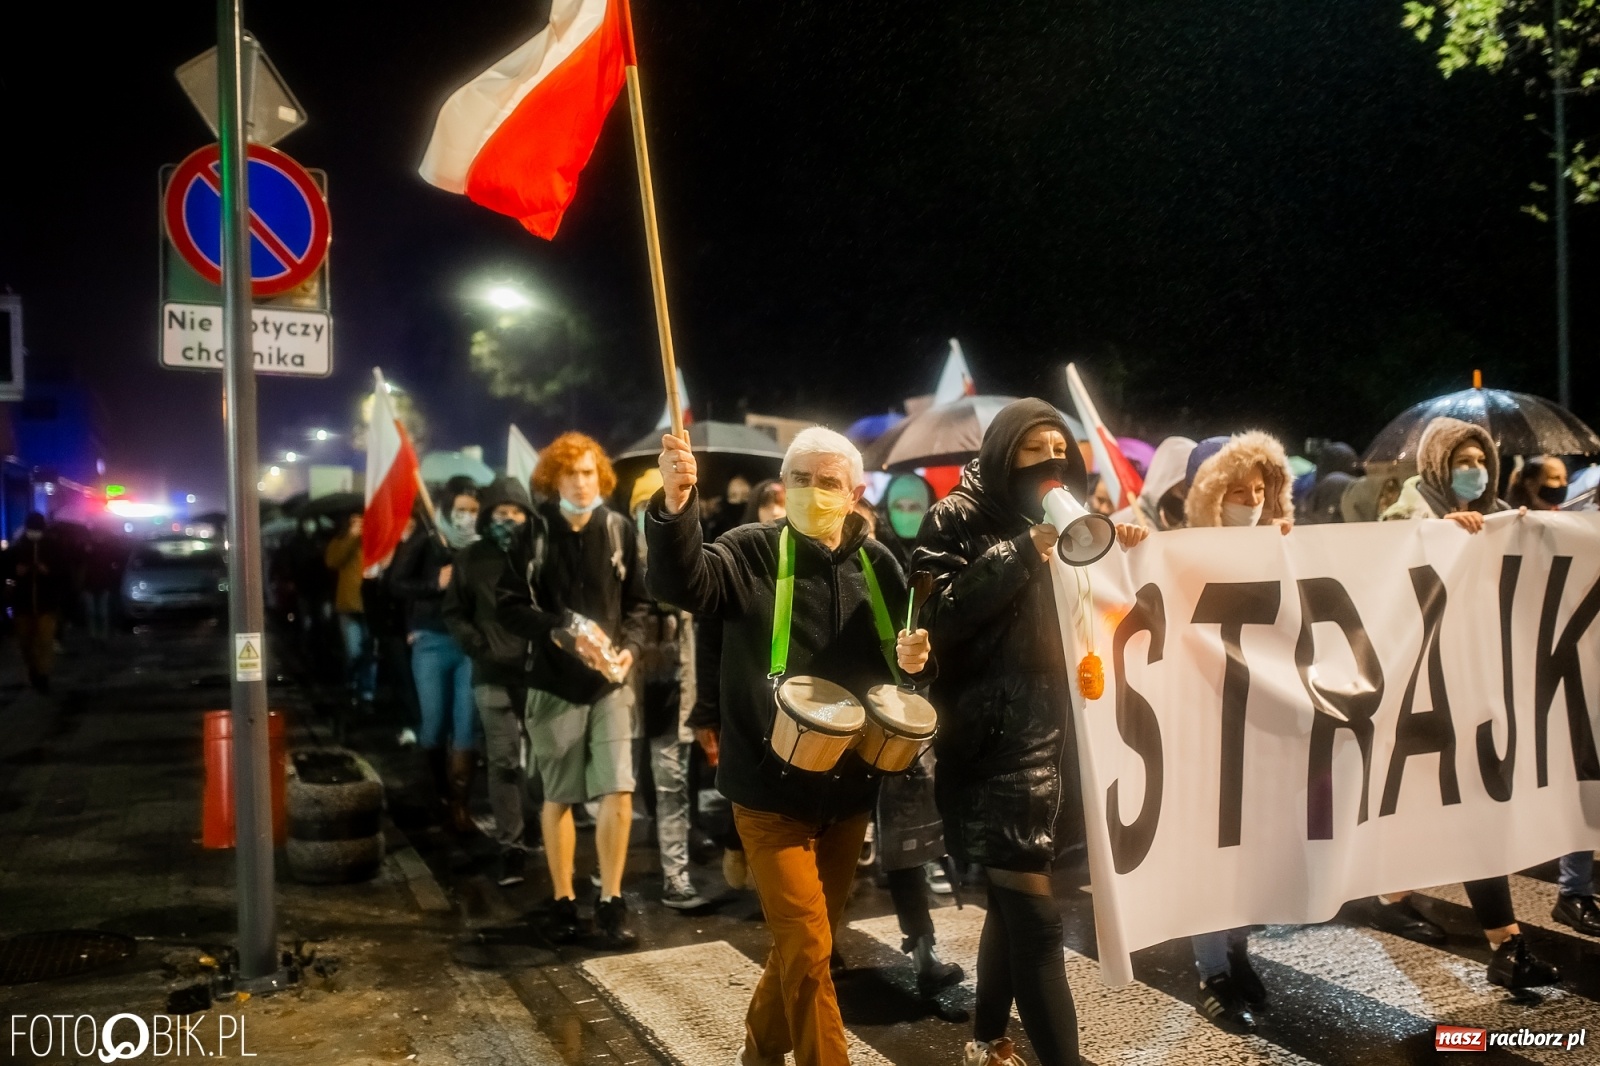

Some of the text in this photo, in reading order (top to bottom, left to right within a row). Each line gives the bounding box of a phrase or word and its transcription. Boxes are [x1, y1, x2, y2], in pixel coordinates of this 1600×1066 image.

[168, 309, 212, 332] Nie
[181, 342, 305, 367] chonika
[1106, 554, 1600, 875] STRAJK
